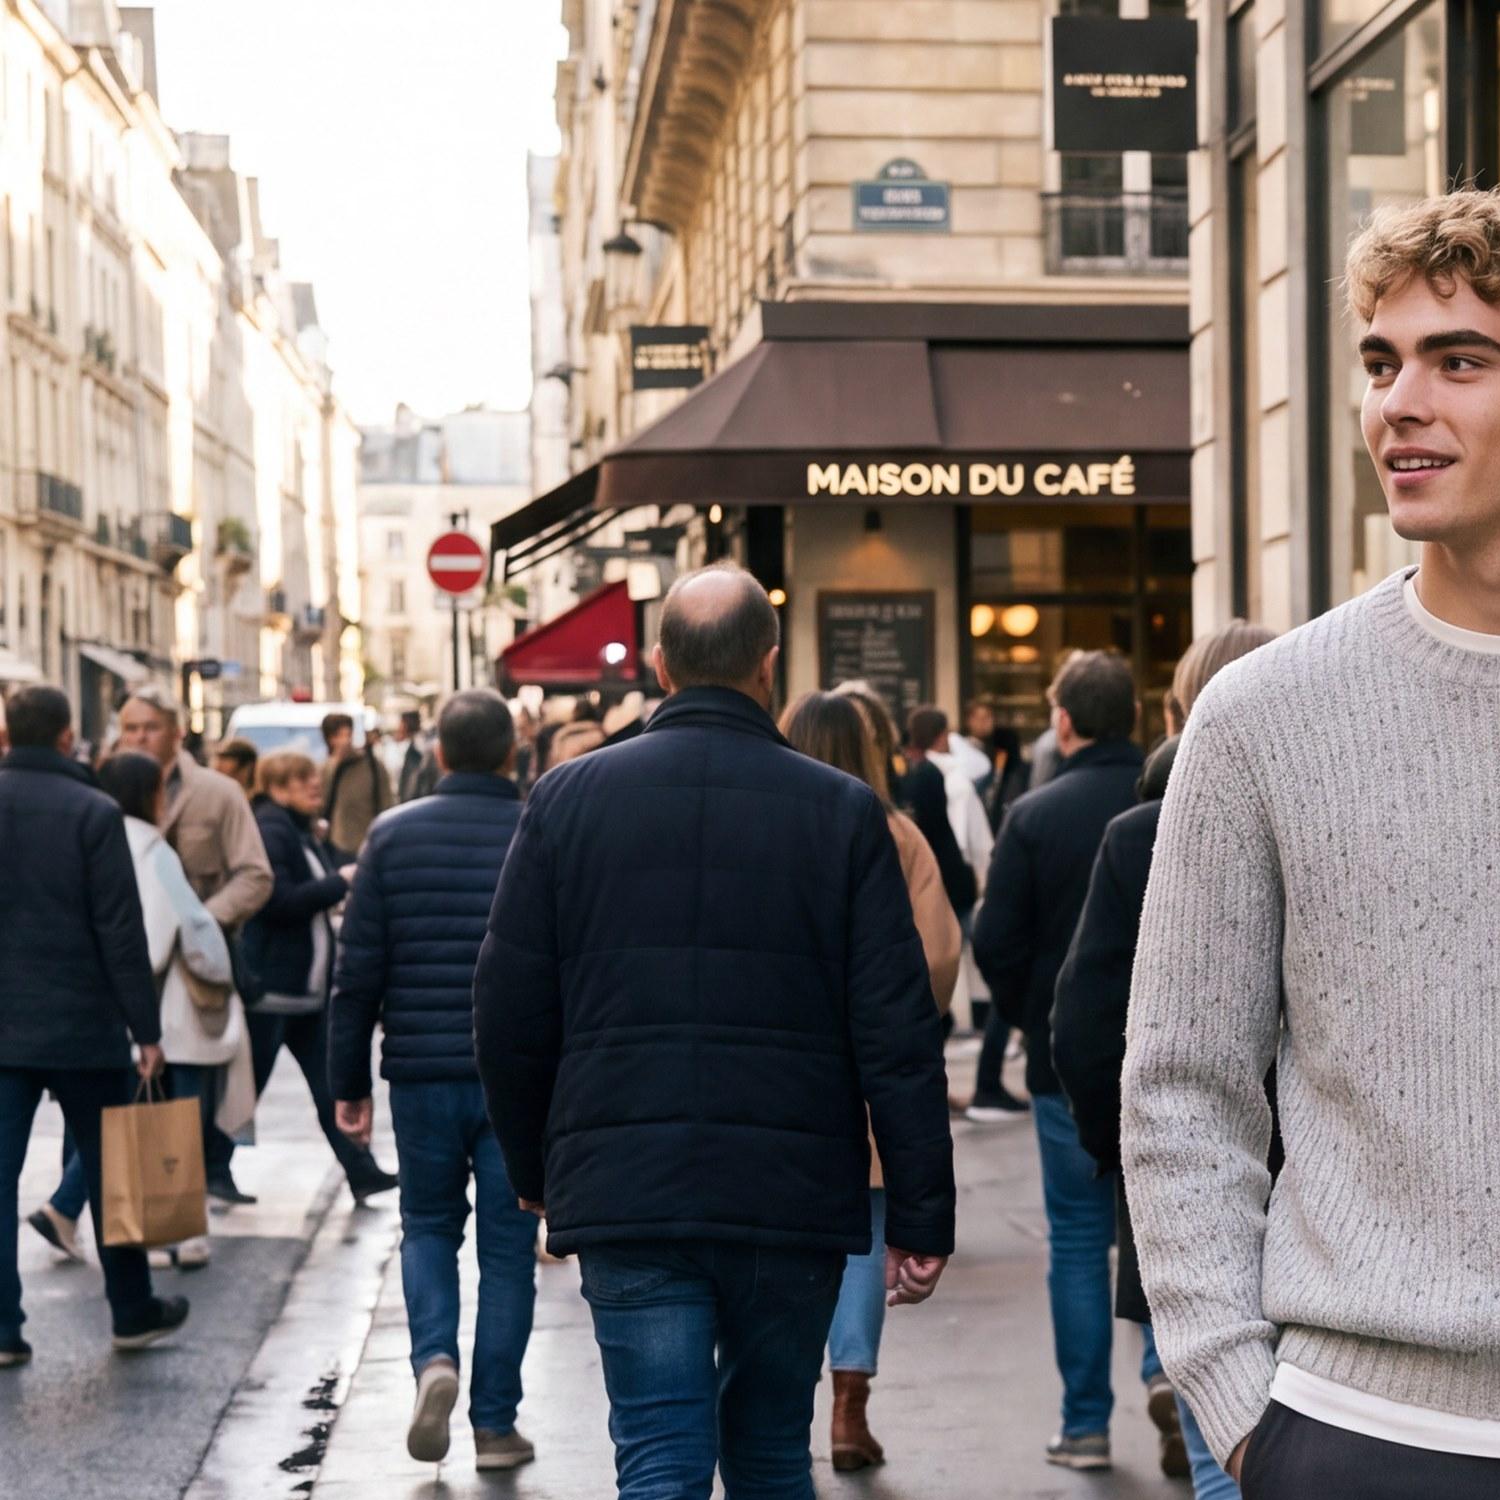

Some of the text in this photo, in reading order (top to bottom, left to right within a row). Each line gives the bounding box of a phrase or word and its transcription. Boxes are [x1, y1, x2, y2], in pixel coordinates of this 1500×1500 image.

[807, 455, 1136, 495] MAISON DU CAFÉ
